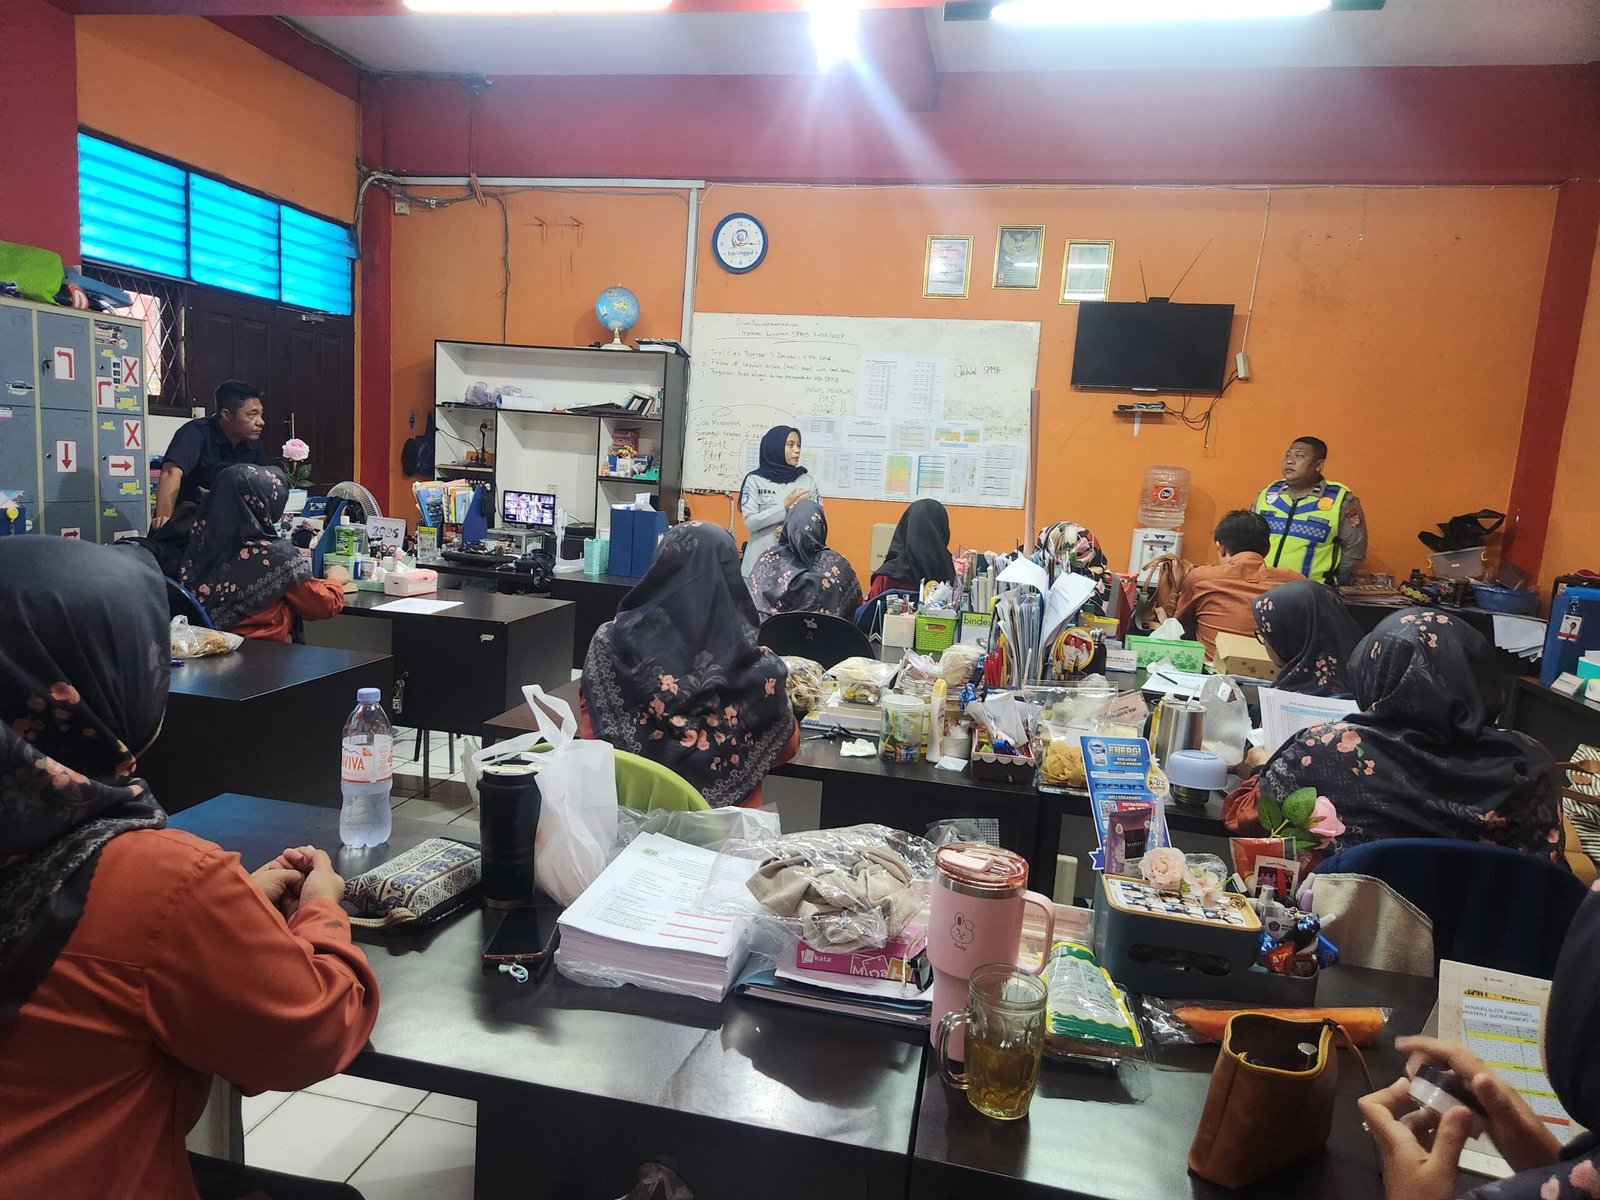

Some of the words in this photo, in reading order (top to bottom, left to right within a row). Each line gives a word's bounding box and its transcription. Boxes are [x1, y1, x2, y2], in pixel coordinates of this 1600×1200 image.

[736, 249, 754, 257] Unggul
[983, 365, 1001, 375] SPMB
[1108, 746, 1142, 756] ENERGI
[814, 954, 832, 964] kata
